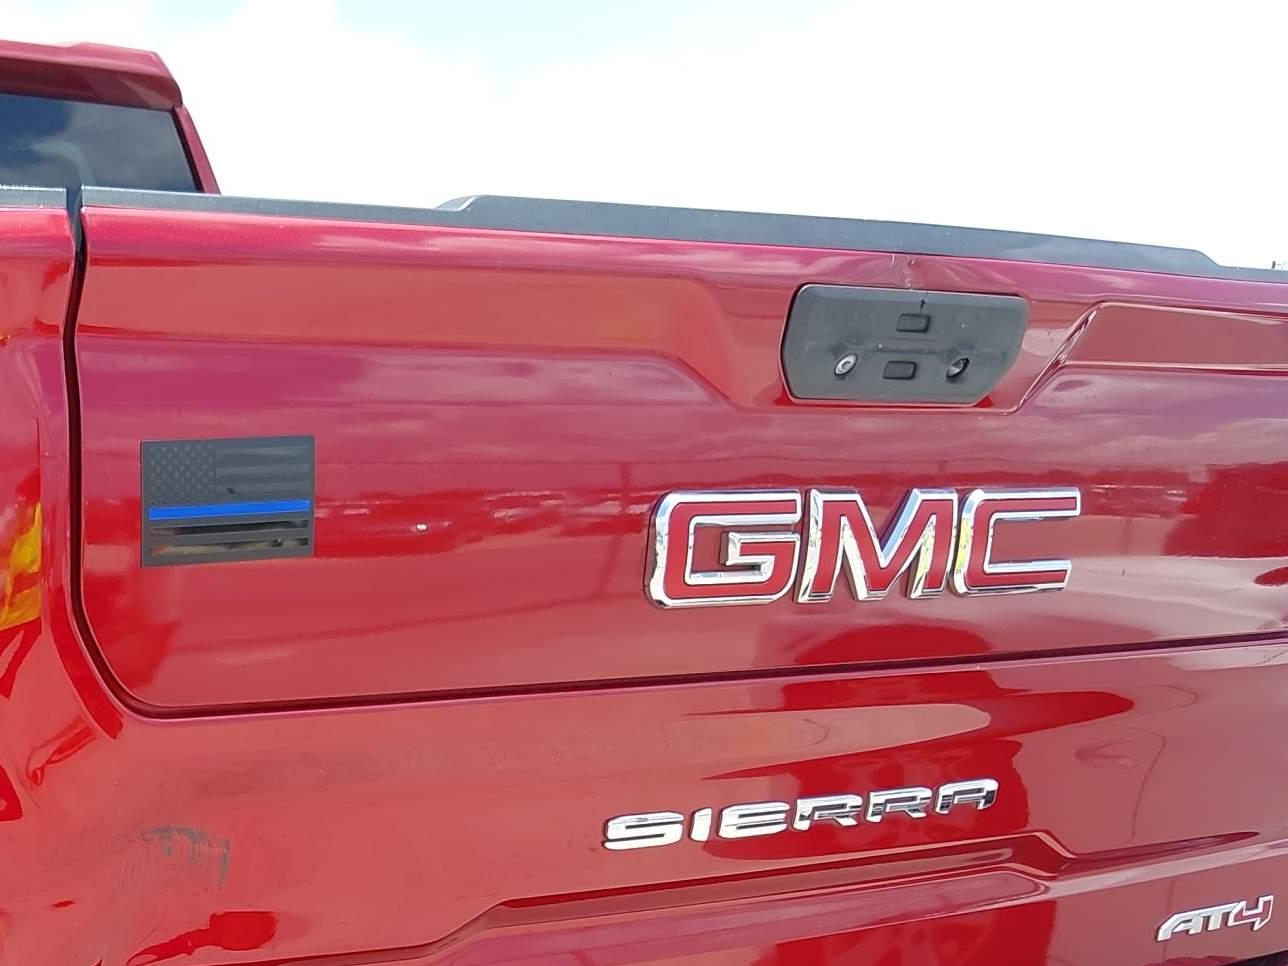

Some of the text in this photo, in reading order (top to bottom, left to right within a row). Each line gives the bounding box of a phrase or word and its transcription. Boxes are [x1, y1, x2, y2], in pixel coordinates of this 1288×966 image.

[647, 486, 1082, 607] GMC
[602, 779, 1000, 851] SIERRA
[1155, 894, 1274, 942] AT4
